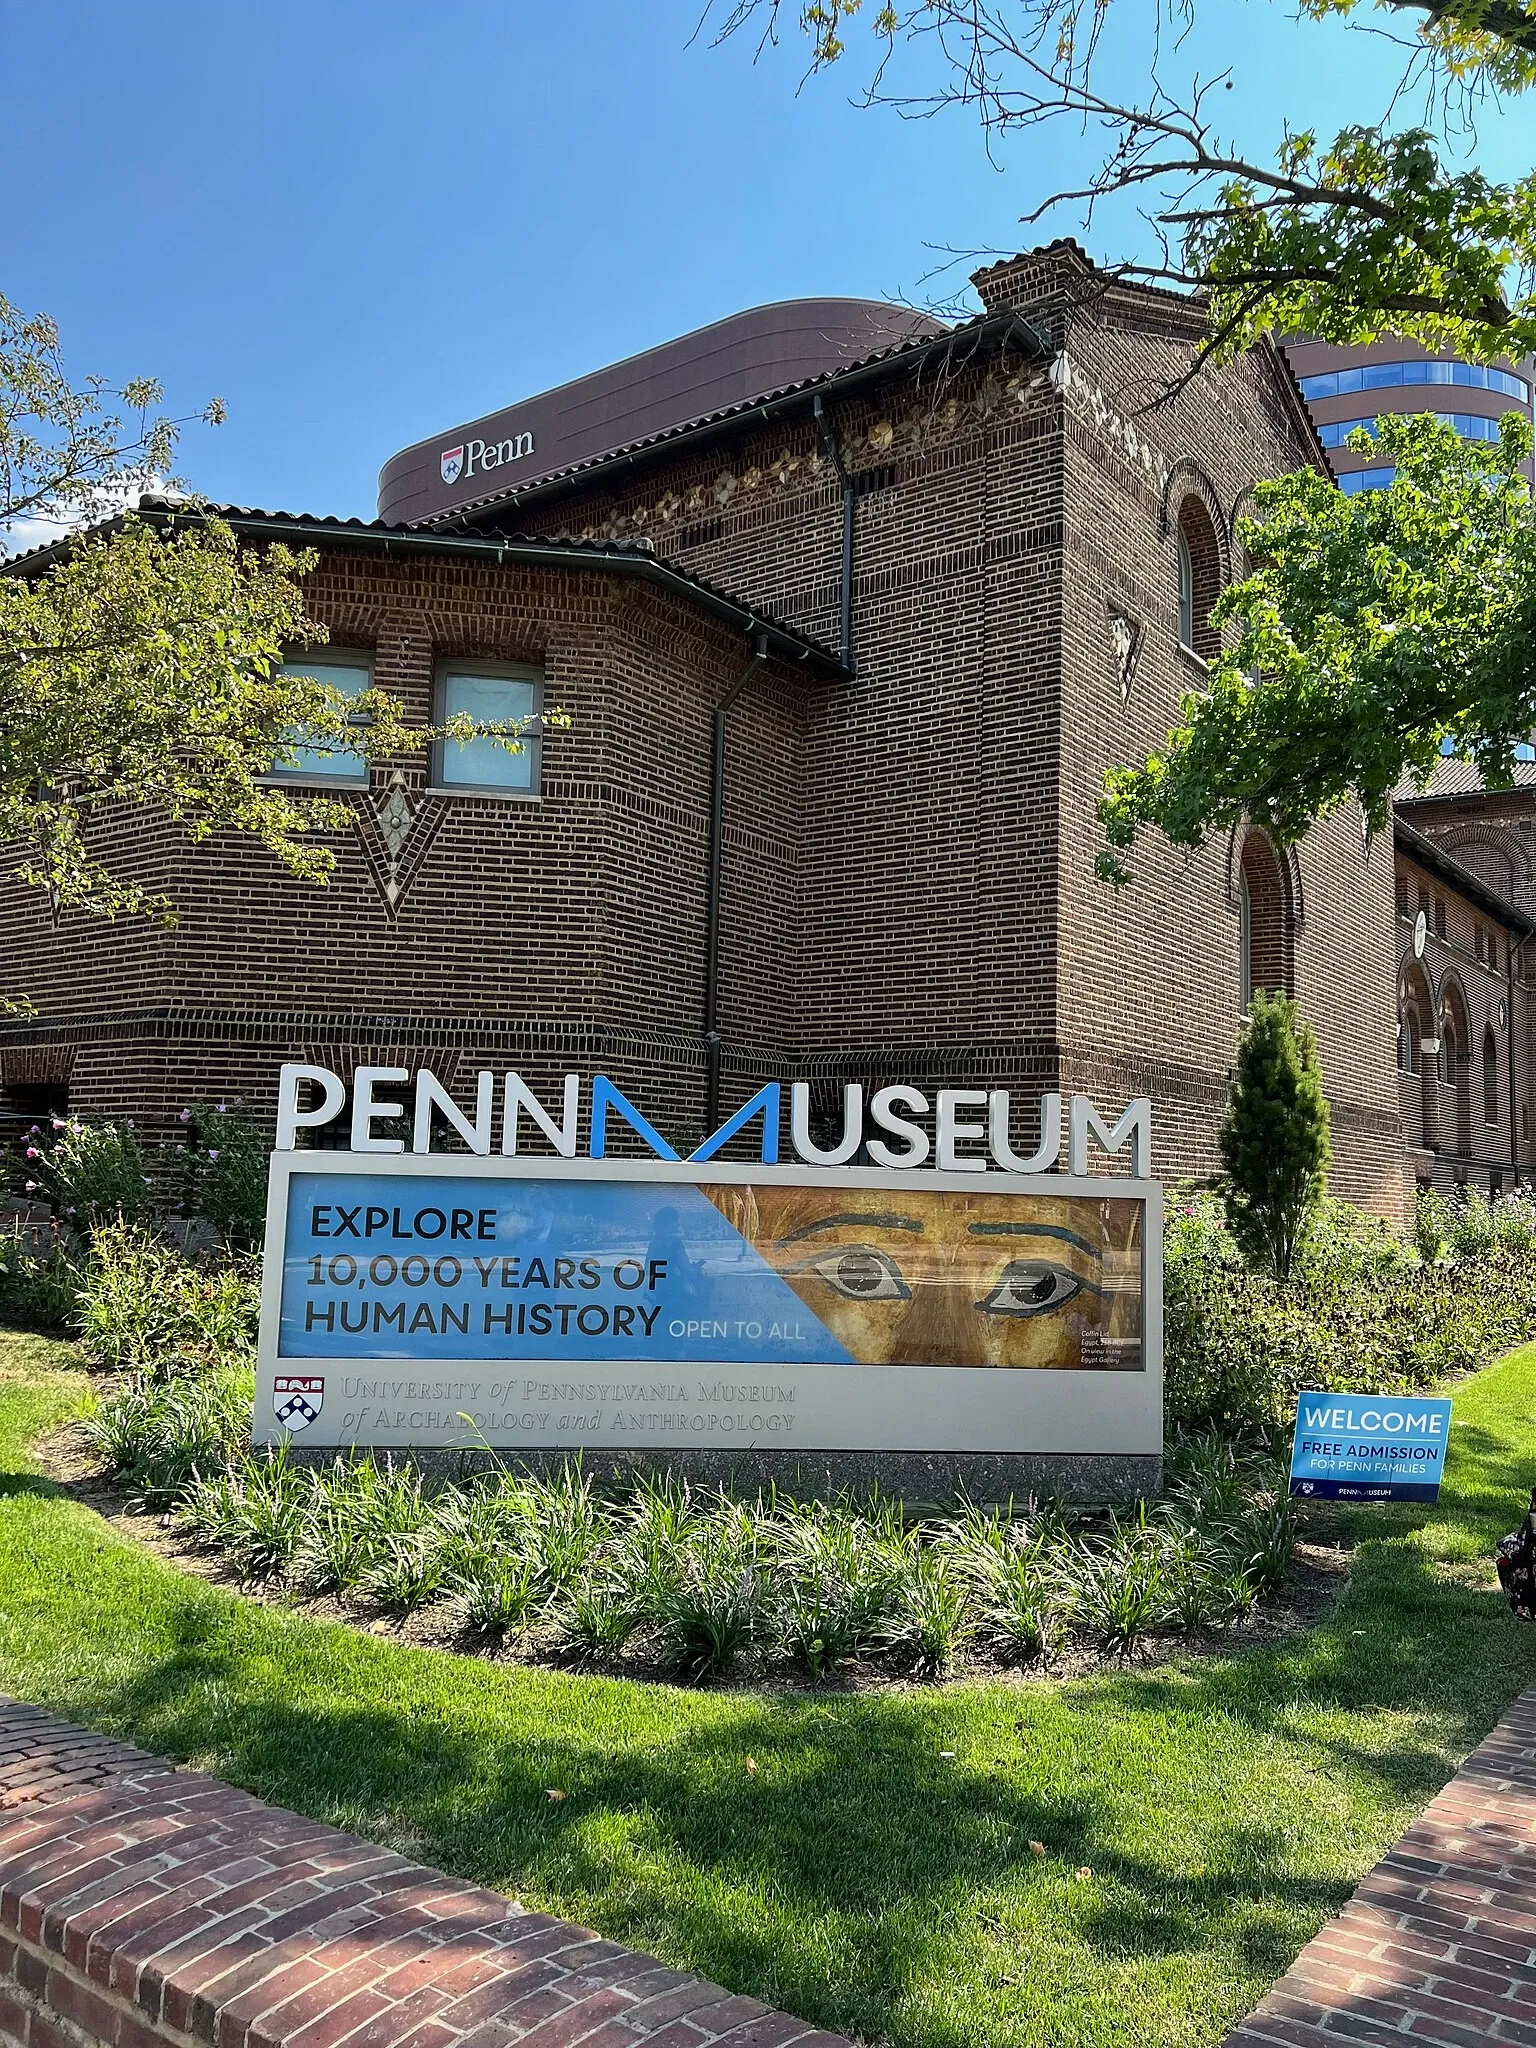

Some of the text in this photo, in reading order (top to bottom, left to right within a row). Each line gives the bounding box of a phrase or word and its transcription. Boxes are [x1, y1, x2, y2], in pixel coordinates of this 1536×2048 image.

[465, 431, 535, 478] Penn
[311, 1205, 497, 1241] EXPLORE
[307, 1253, 669, 1291] 10,000 YEARS OF
[305, 1301, 806, 1341] HUMAN HISTORY OPEN TO ALL
[1080, 1356, 1120, 1364] Egypt Gallery
[489, 1379, 516, 1405] of
[340, 1406, 369, 1433] of
[557, 1408, 600, 1430] and
[1305, 1408, 1443, 1434] WELCOME
[1302, 1441, 1438, 1460] FREE ADMISSION
[1310, 1459, 1426, 1474] FOR PENN FAMILIES
